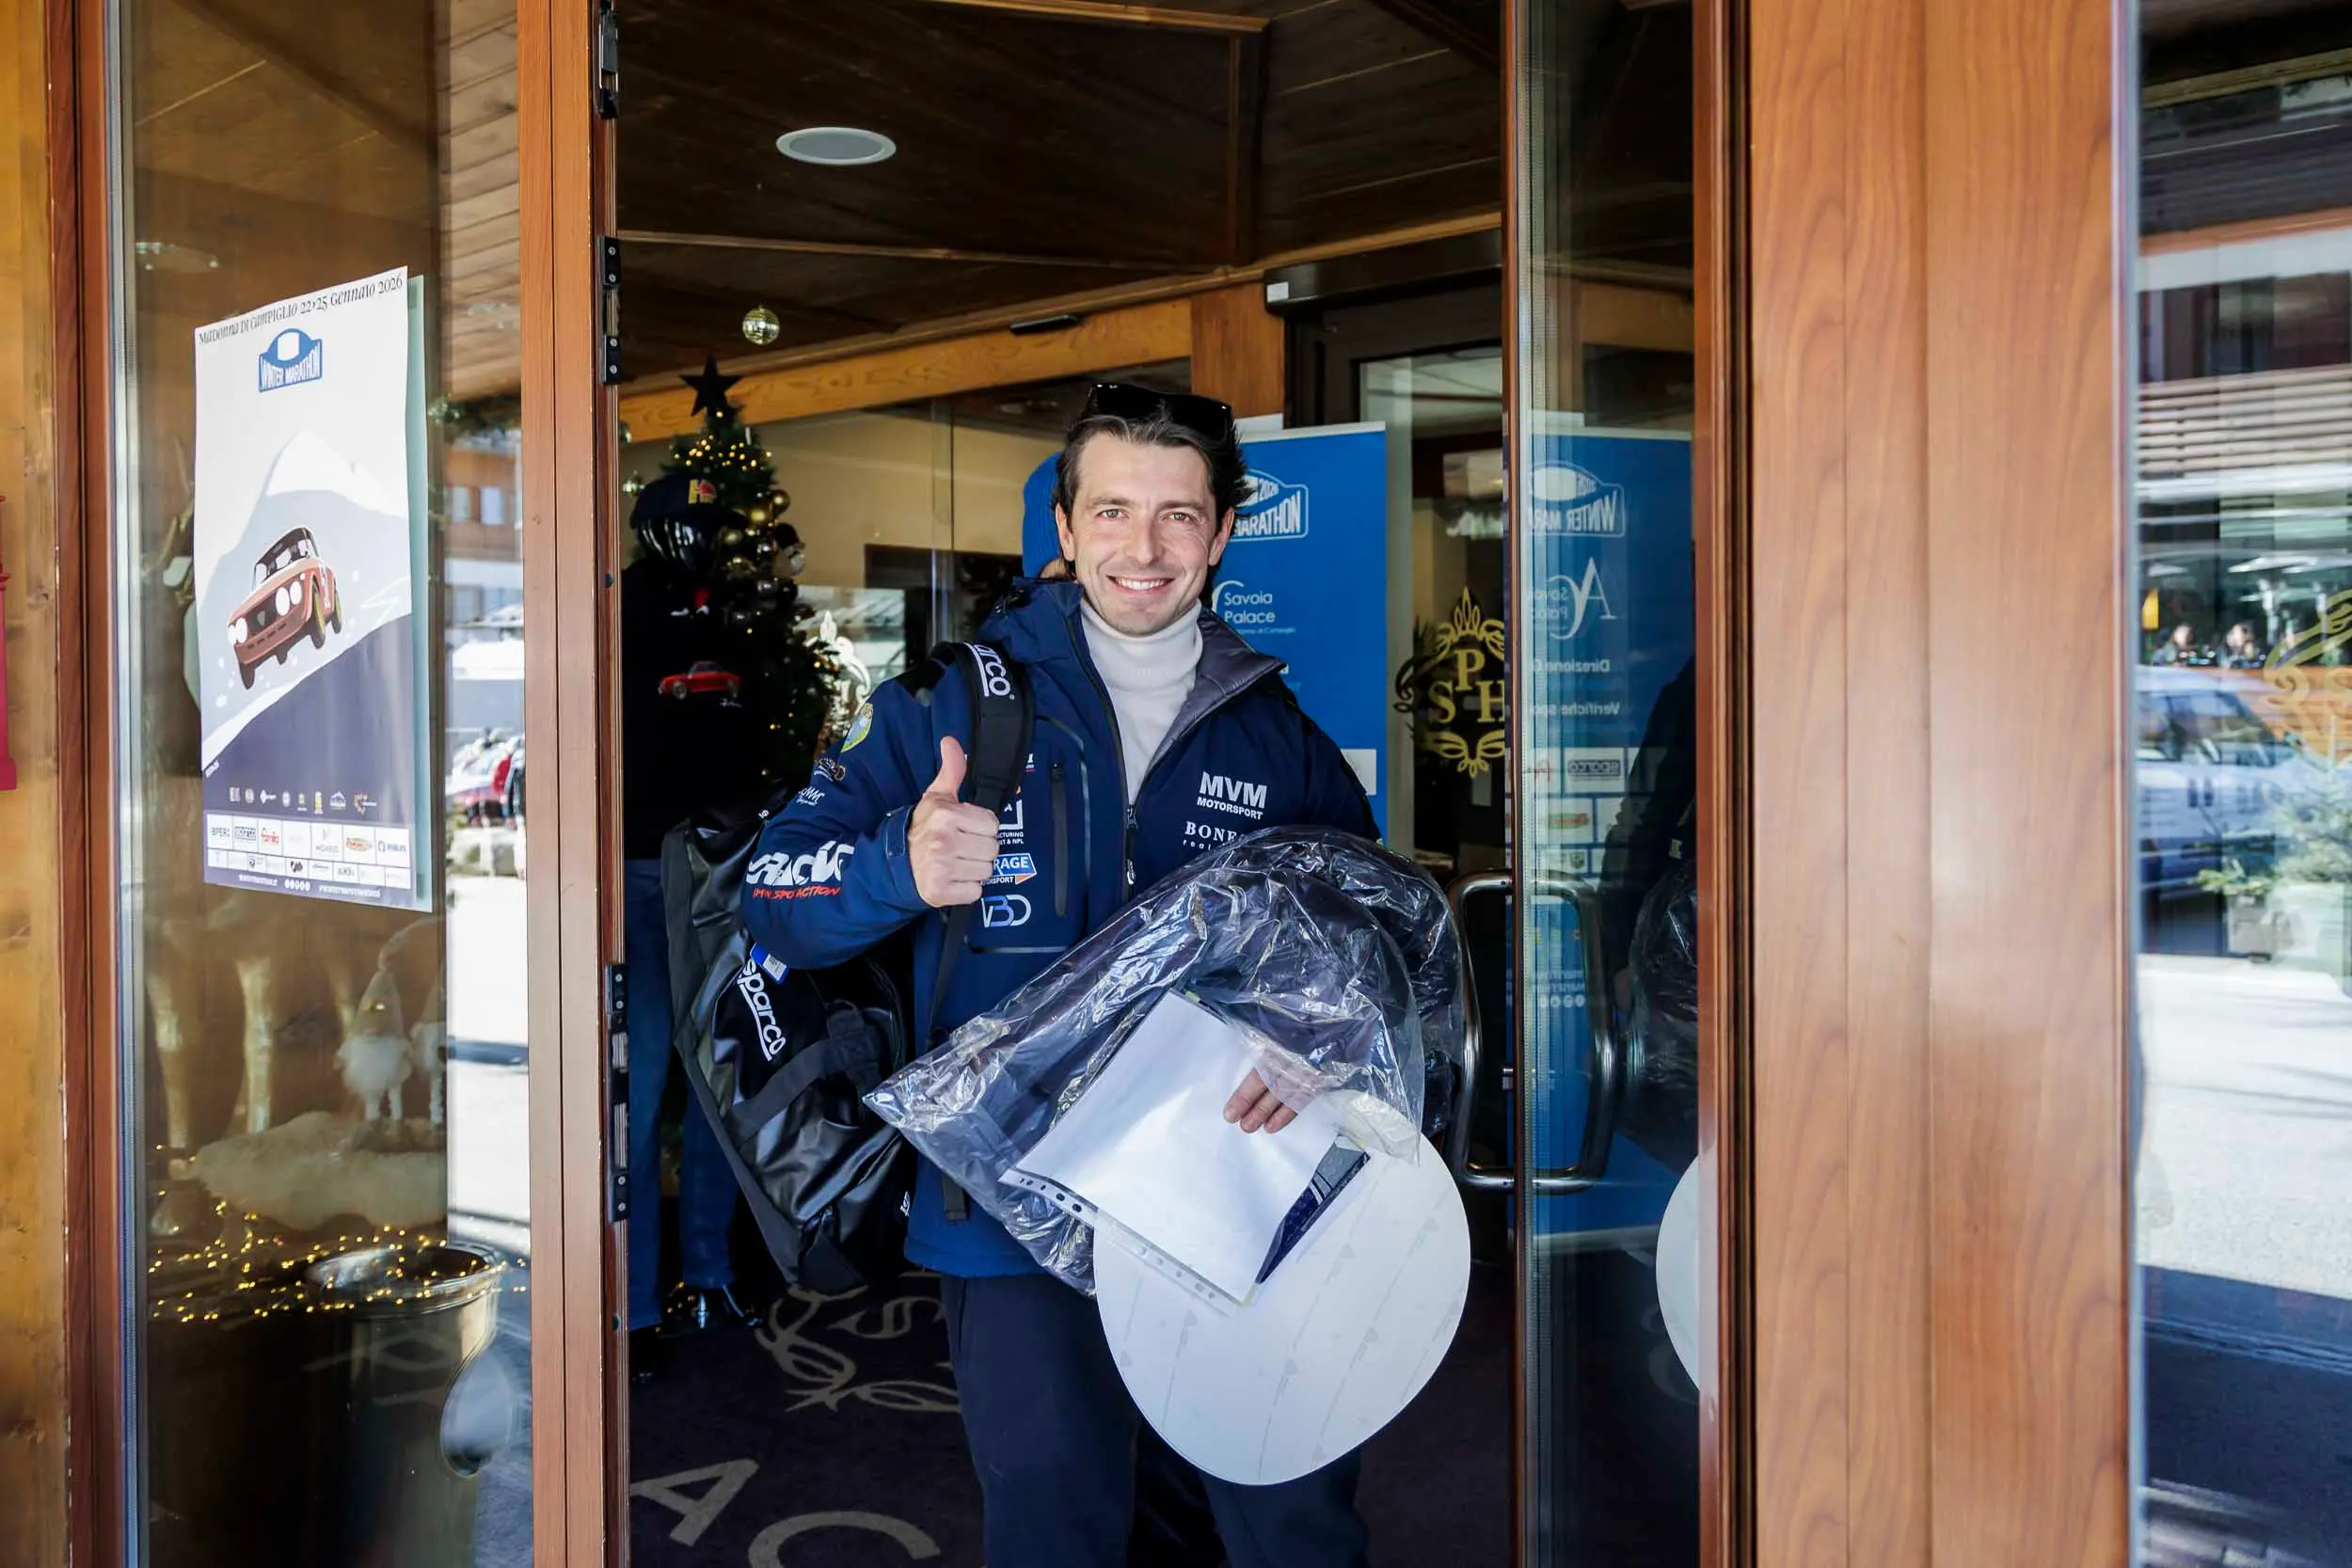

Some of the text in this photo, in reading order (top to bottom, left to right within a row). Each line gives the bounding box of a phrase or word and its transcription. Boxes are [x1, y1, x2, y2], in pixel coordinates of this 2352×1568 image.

[378, 272, 403, 294] 2026
[1224, 590, 1273, 607] Savoia
[1224, 610, 1276, 625] Palace
[1454, 648, 1486, 691] P
[1428, 679, 1456, 723] S
[1200, 770, 1268, 809] MVM
[1197, 796, 1263, 820] MOTORSPORT
[737, 958, 787, 1057] sparco
